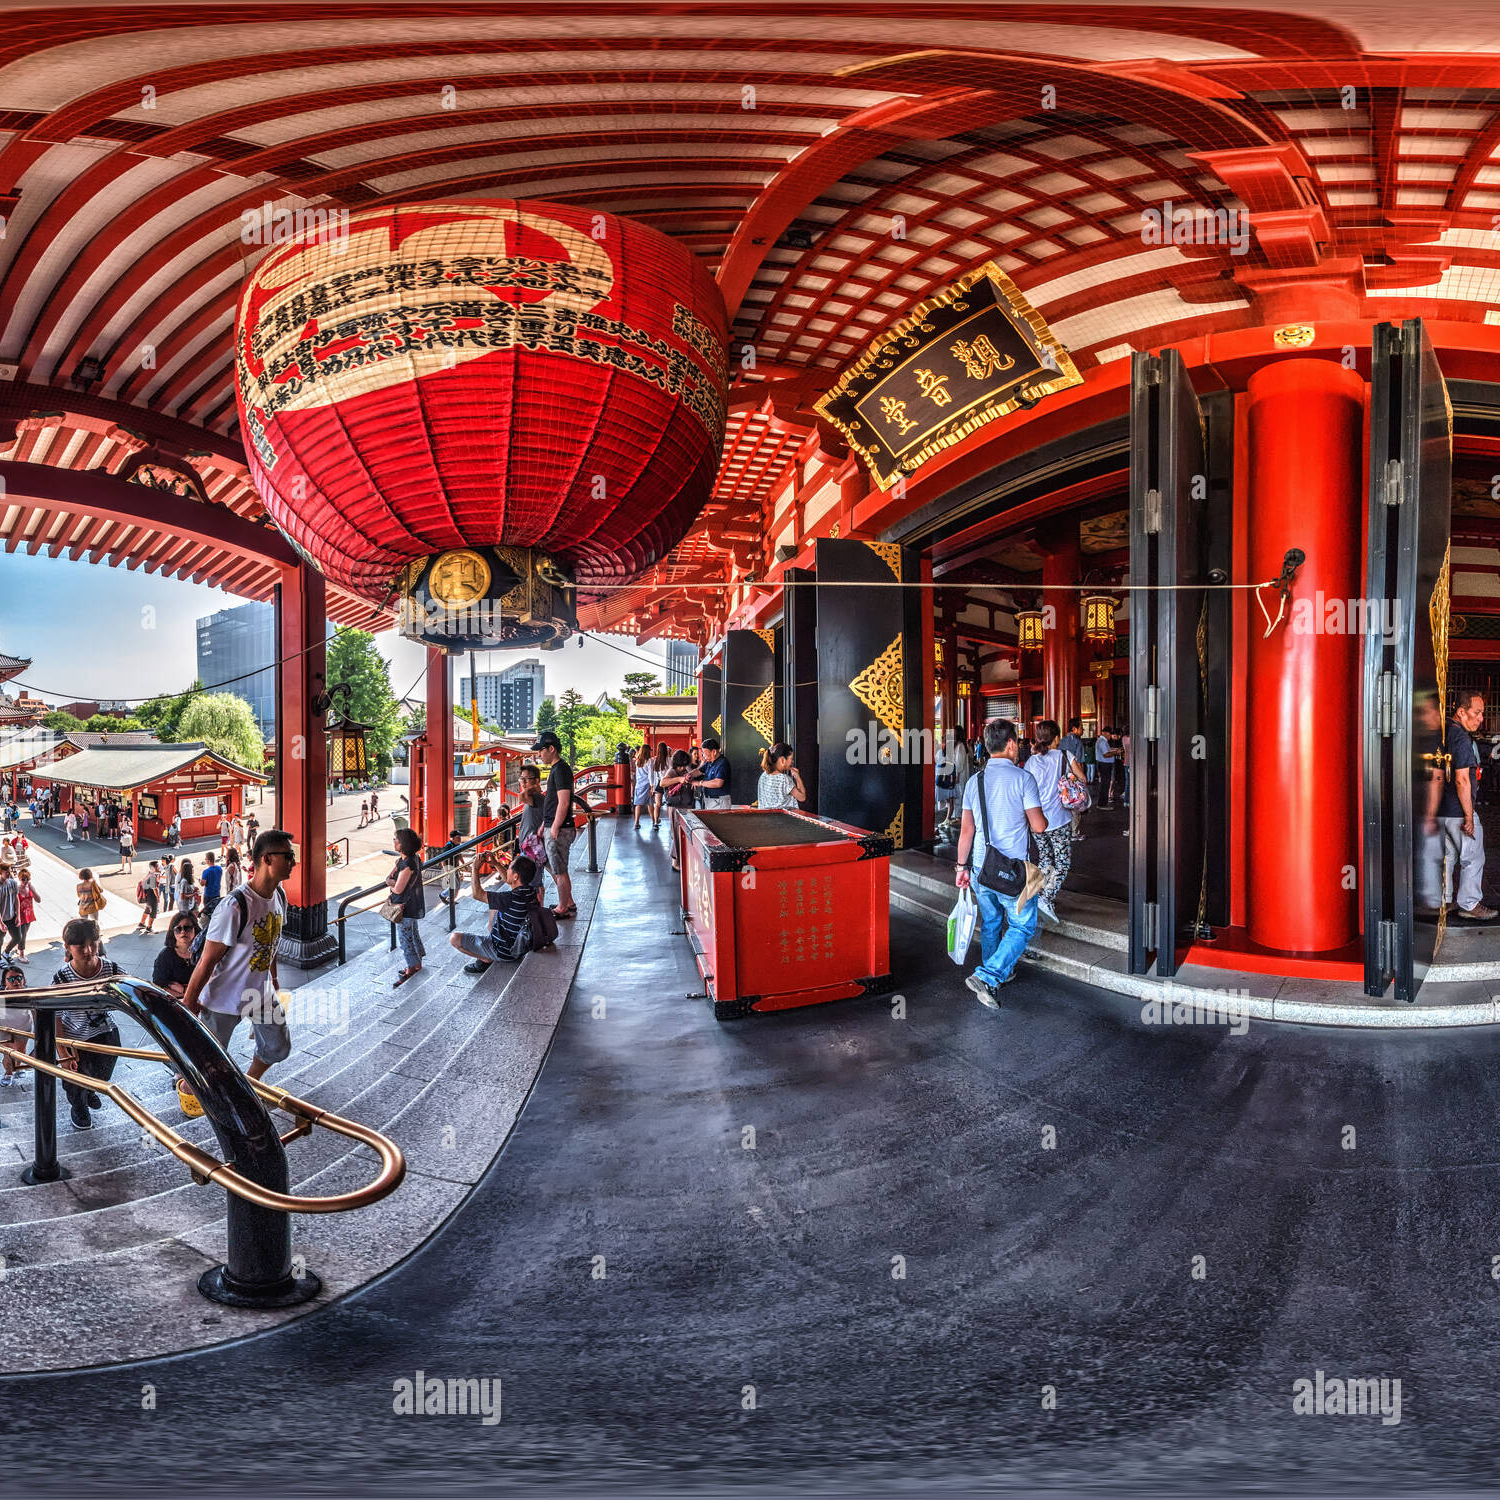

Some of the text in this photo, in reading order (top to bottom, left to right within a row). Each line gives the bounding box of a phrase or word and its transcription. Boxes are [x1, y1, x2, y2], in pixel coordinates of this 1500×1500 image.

[419, 302, 455, 349] 元千代
[516, 304, 549, 349] 三重子
